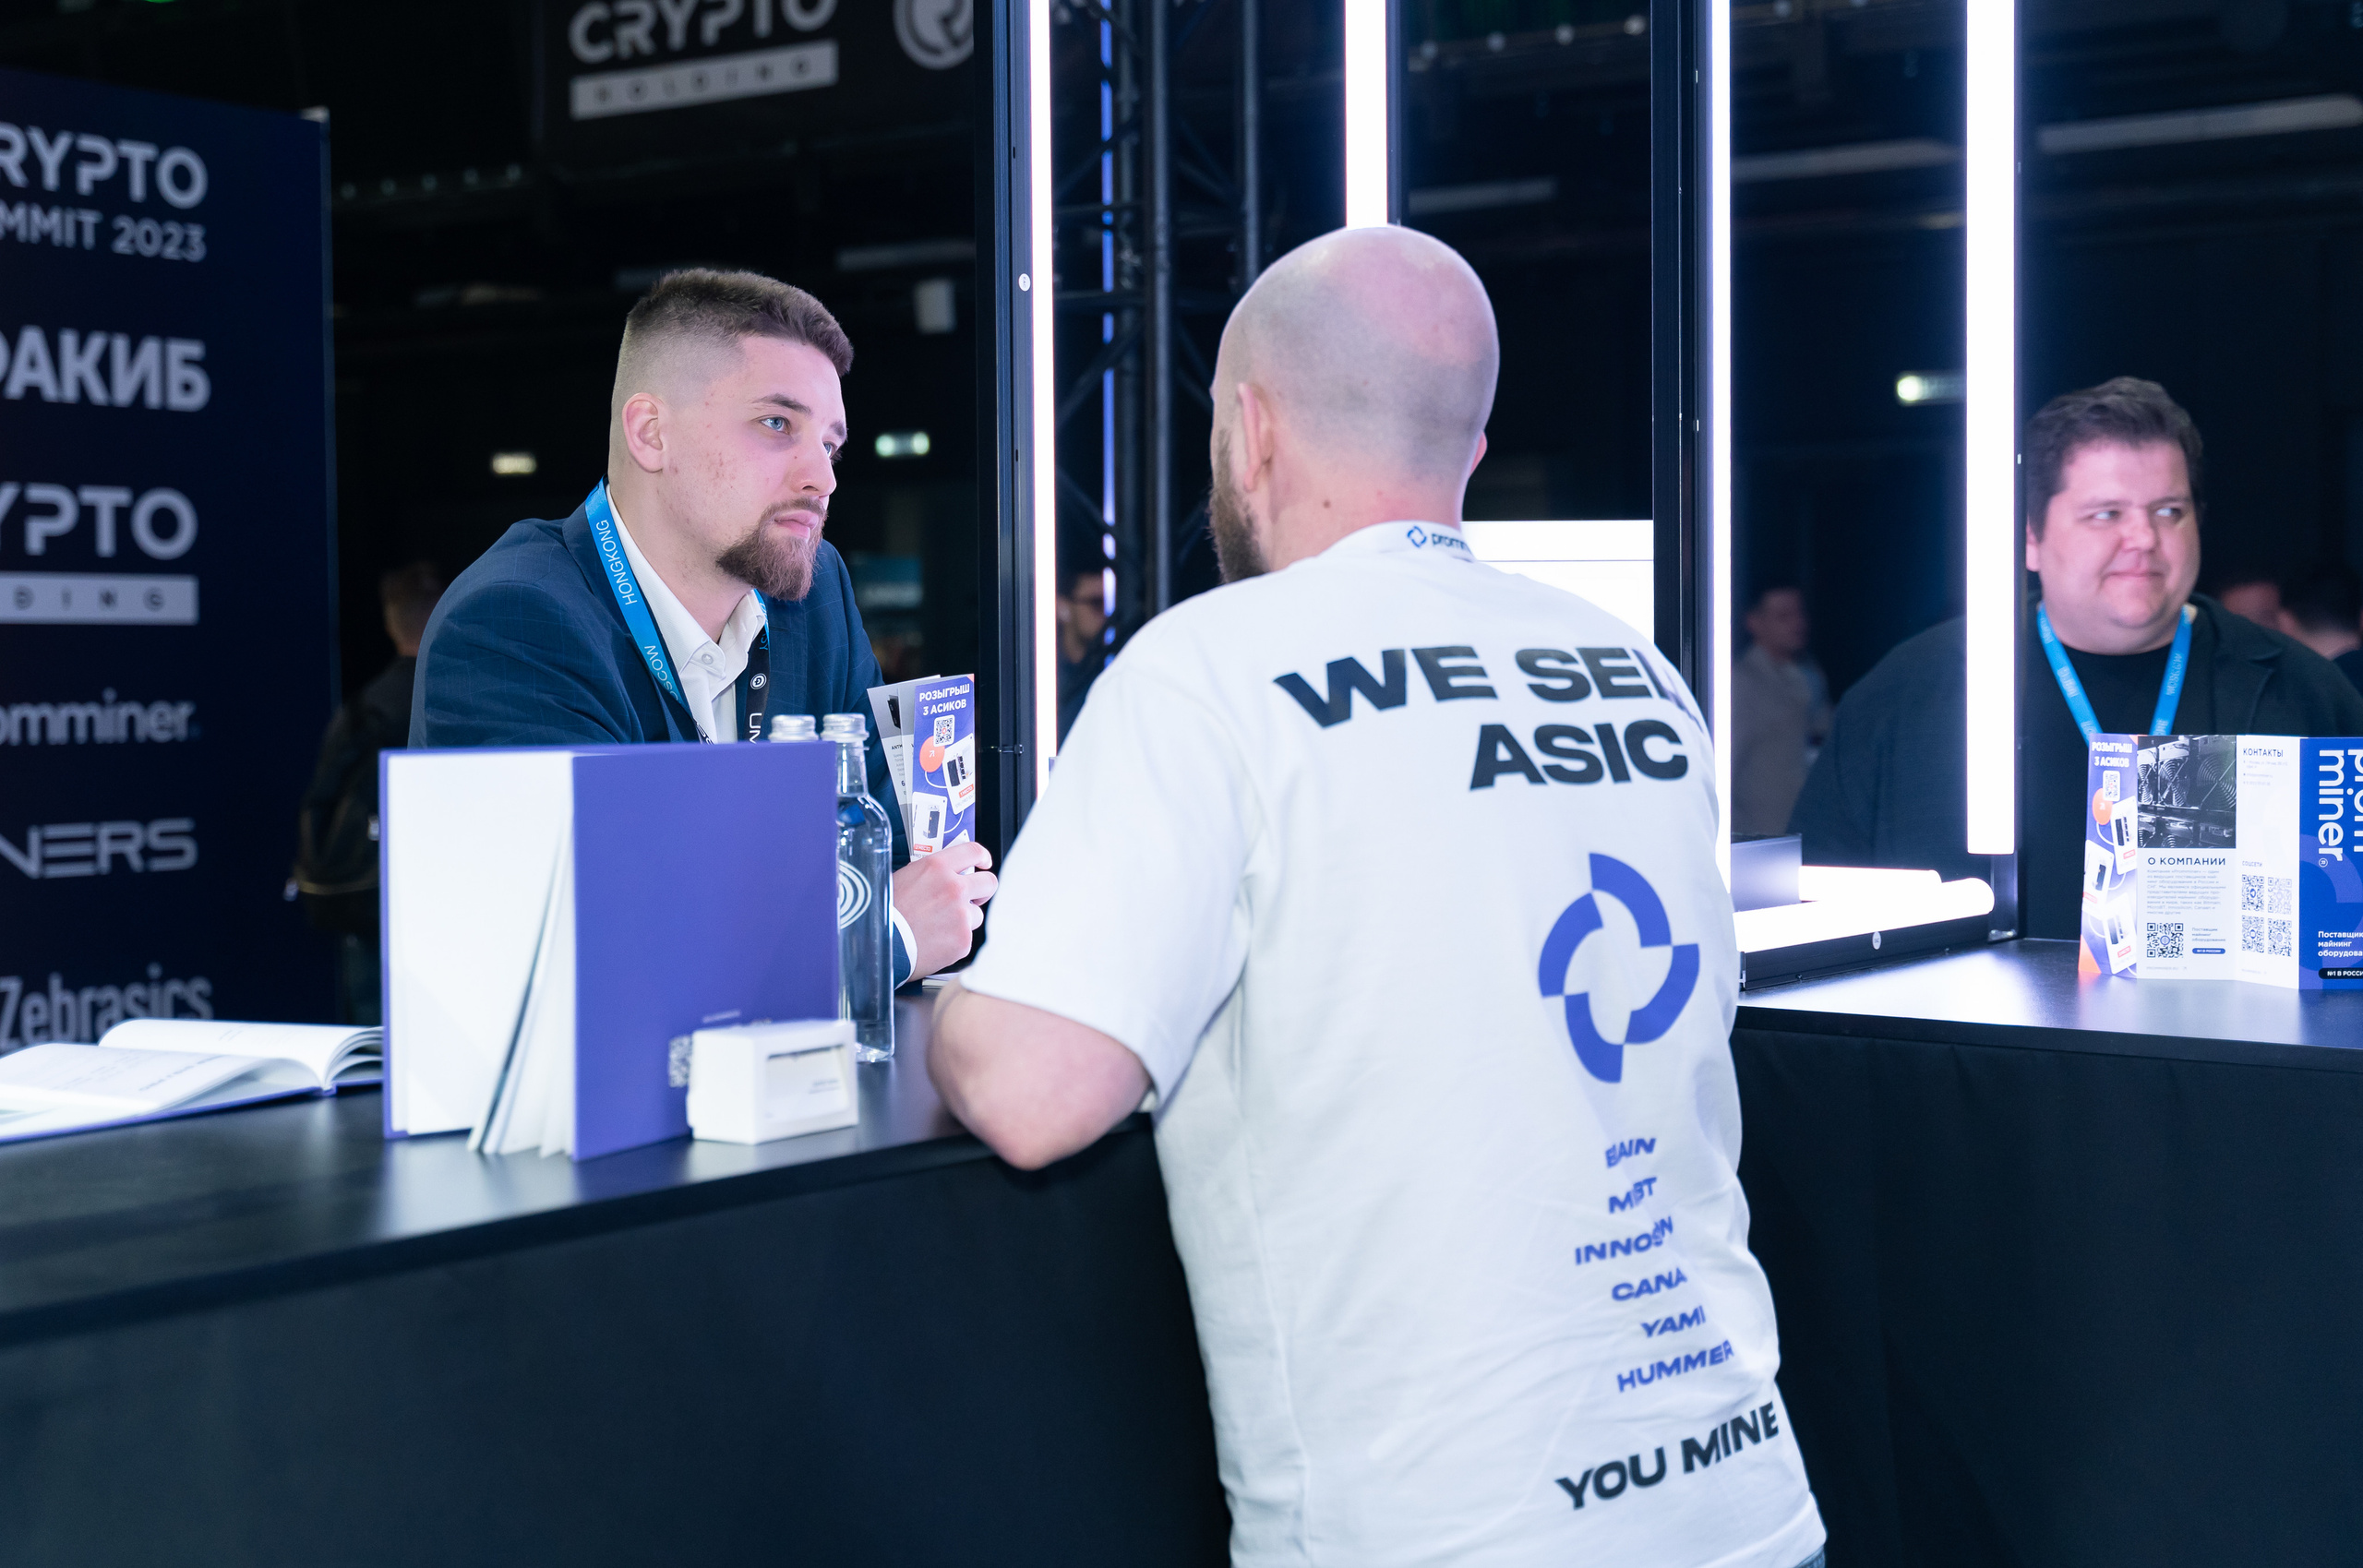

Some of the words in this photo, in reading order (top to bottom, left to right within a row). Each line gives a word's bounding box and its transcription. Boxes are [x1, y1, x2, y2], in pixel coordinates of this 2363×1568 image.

[111, 214, 208, 263] 2023
[0, 324, 212, 413] АКИБ
[595, 520, 638, 605] HONGKONG
[0, 686, 197, 746] mminer
[919, 684, 969, 702] РОЗЫГРЫШ
[923, 706, 929, 715] 3
[930, 699, 966, 714] АСИКОВ
[1273, 646, 1498, 729] WE
[1469, 719, 1688, 791] ASIC
[2243, 748, 2284, 757] КОНТАКТЫ
[2160, 857, 2226, 866] КОМПАНИИ
[1617, 1339, 1734, 1393] HUMMER
[1554, 1447, 1668, 1510] YOU
[1681, 1401, 1780, 1475] MINE
